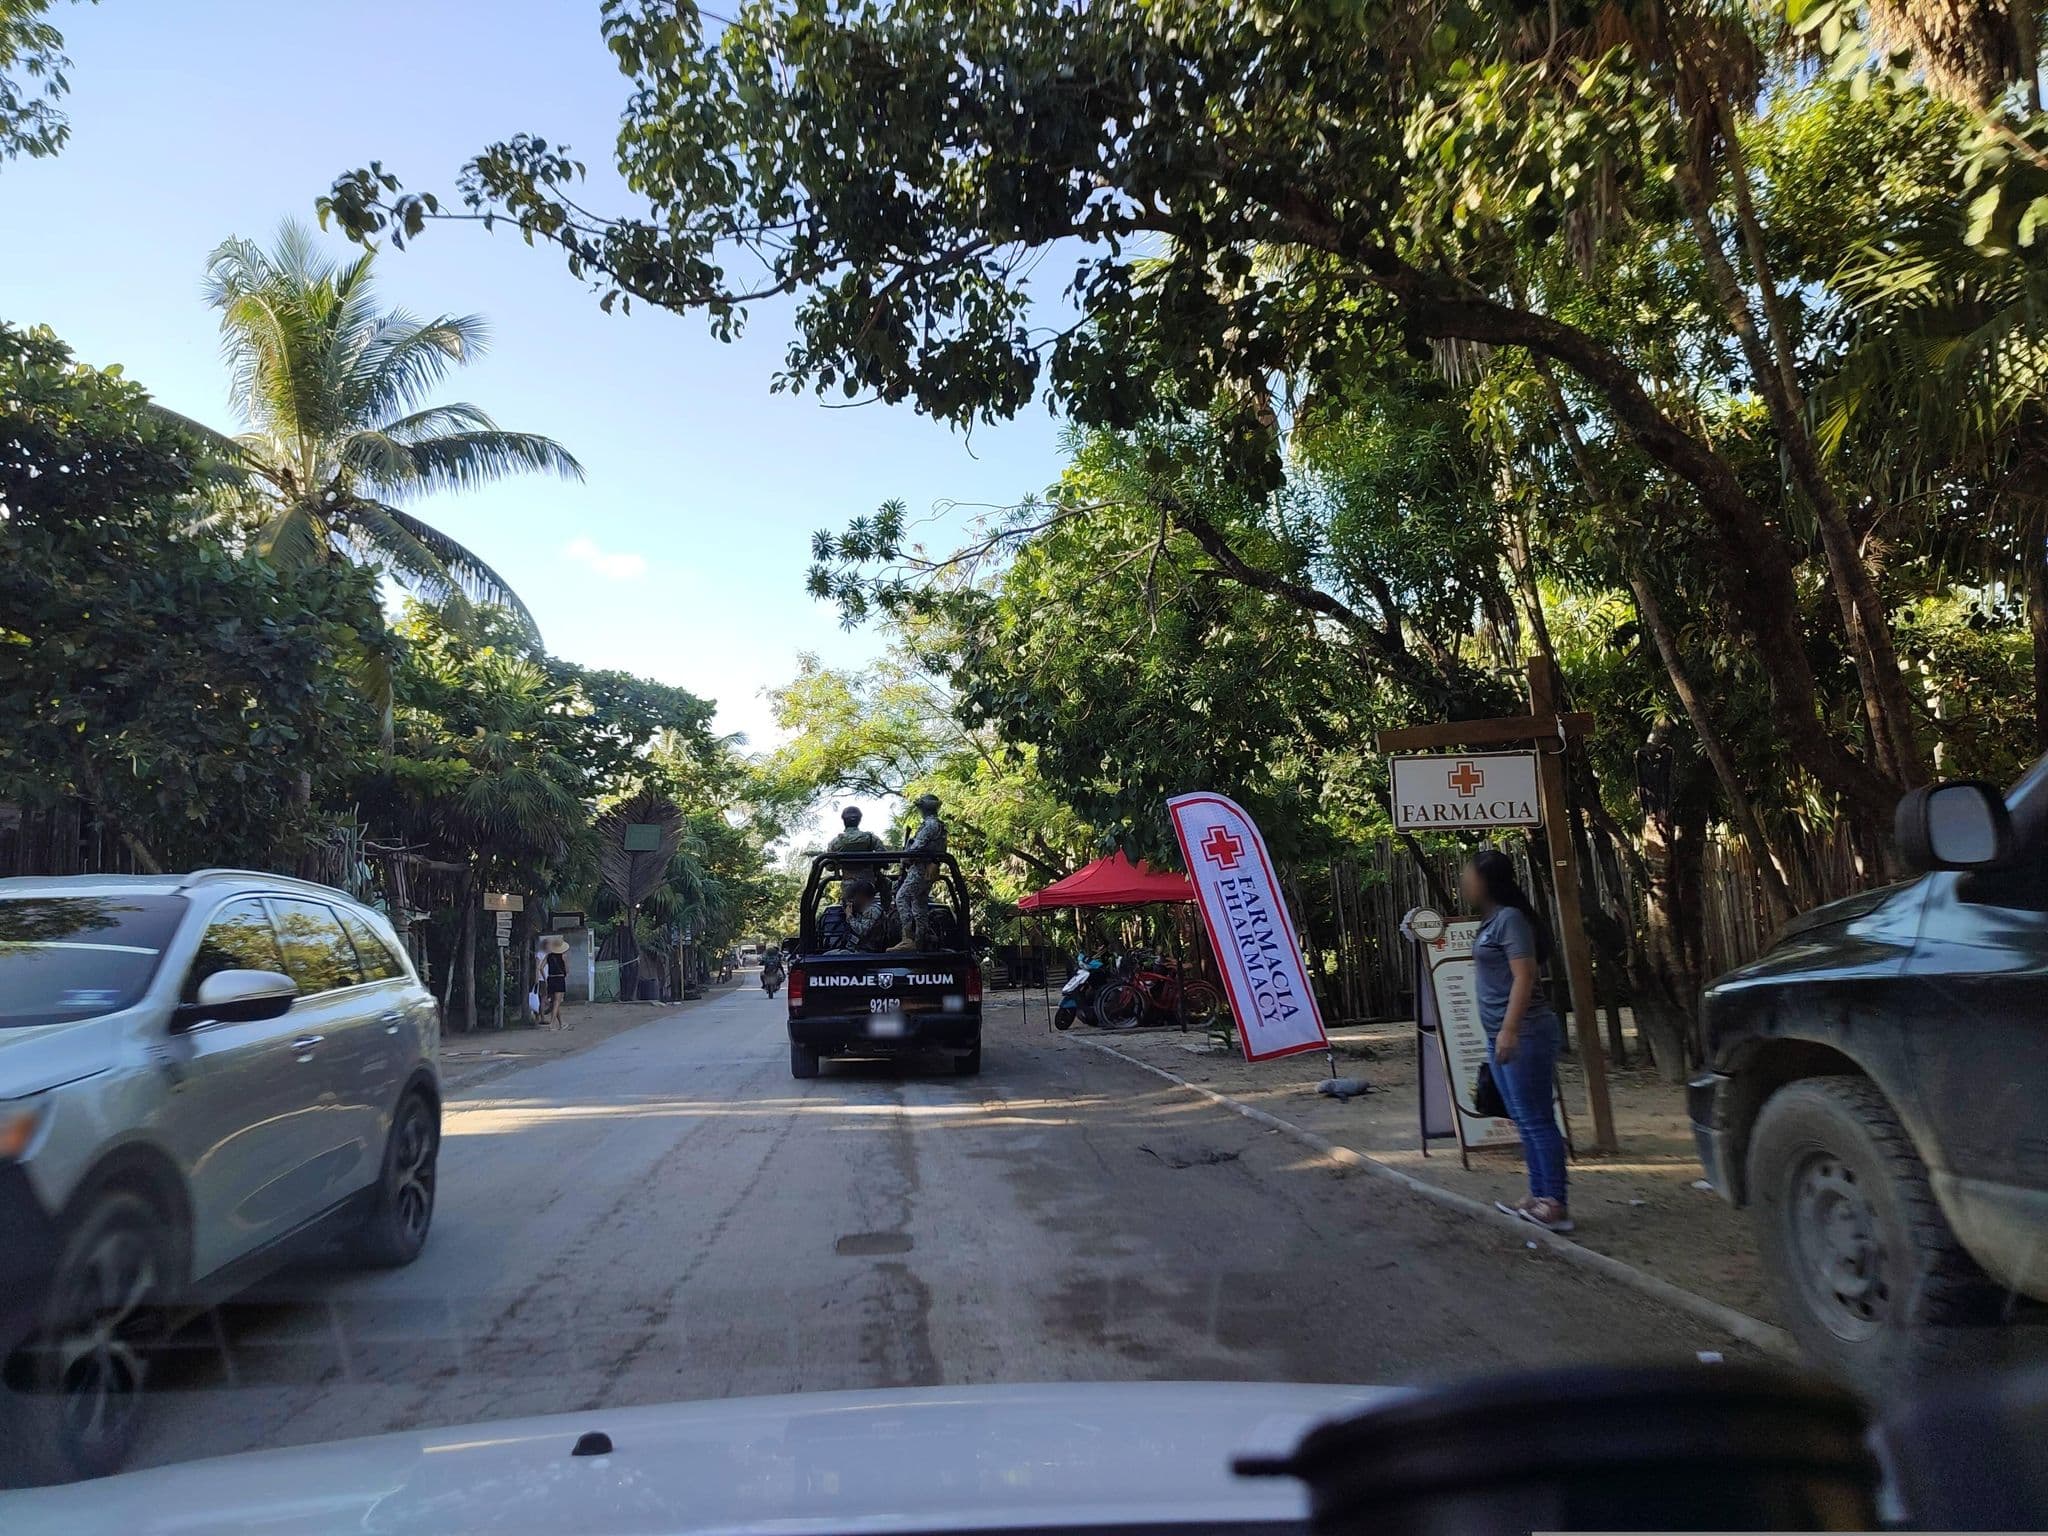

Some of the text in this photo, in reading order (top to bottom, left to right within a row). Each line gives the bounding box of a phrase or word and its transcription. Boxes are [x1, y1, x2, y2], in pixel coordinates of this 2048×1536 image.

[1402, 801, 1534, 823] FARMACIA
[809, 974, 954, 987] BLINDAJE TULUM
[1220, 878, 1281, 1023] PHARMACY
[1238, 875, 1300, 1022] FARMACIA
